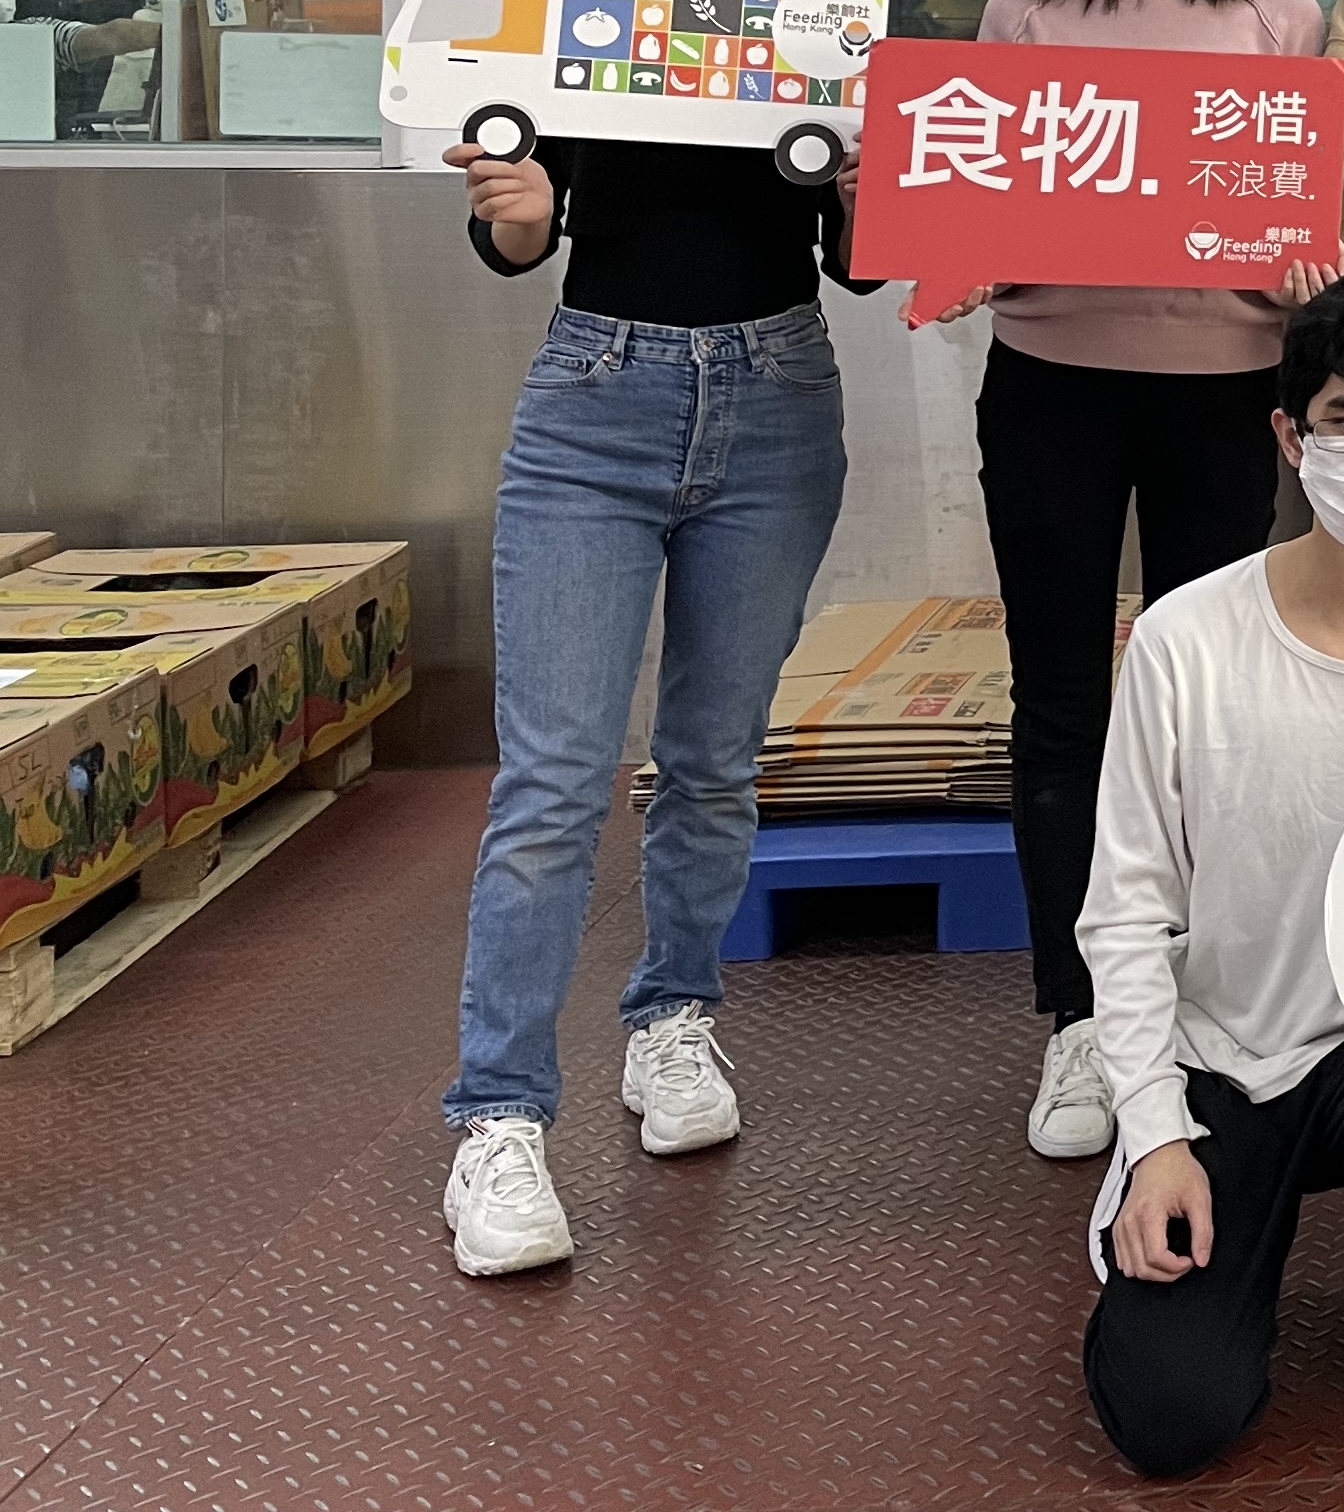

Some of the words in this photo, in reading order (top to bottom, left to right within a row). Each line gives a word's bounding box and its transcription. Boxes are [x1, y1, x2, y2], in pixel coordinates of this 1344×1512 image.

[781, 22, 807, 35] Hong
[809, 22, 835, 36] Kong
[782, 8, 843, 30] Feeding
[1192, 88, 1318, 148] 珍惜,
[896, 76, 1159, 196] 食物.
[1186, 159, 1316, 201] 不浪費.
[1223, 238, 1283, 257] Feeding
[1249, 251, 1274, 265] Kong
